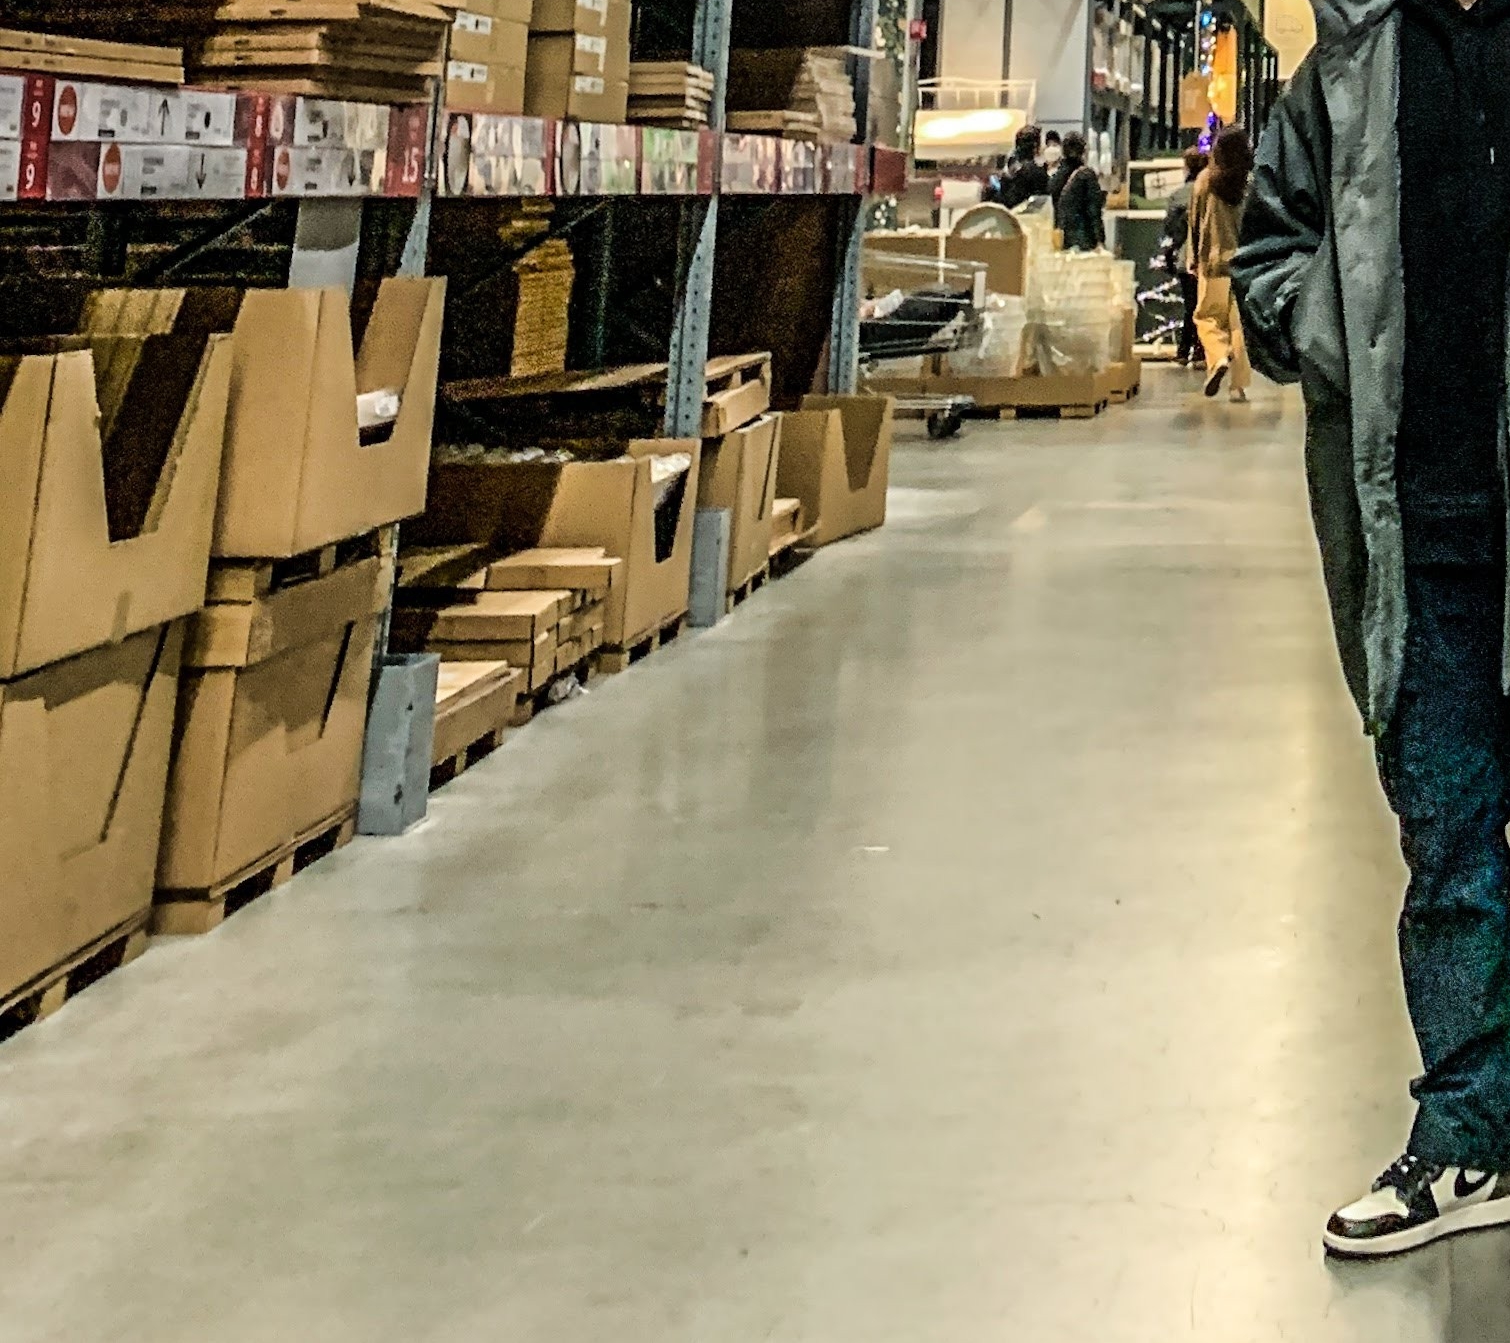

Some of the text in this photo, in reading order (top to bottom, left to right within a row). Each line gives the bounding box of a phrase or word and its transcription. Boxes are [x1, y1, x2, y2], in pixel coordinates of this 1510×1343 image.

[31, 100, 42, 128] 9
[25, 162, 36, 190] 9
[402, 146, 419, 183] 15
